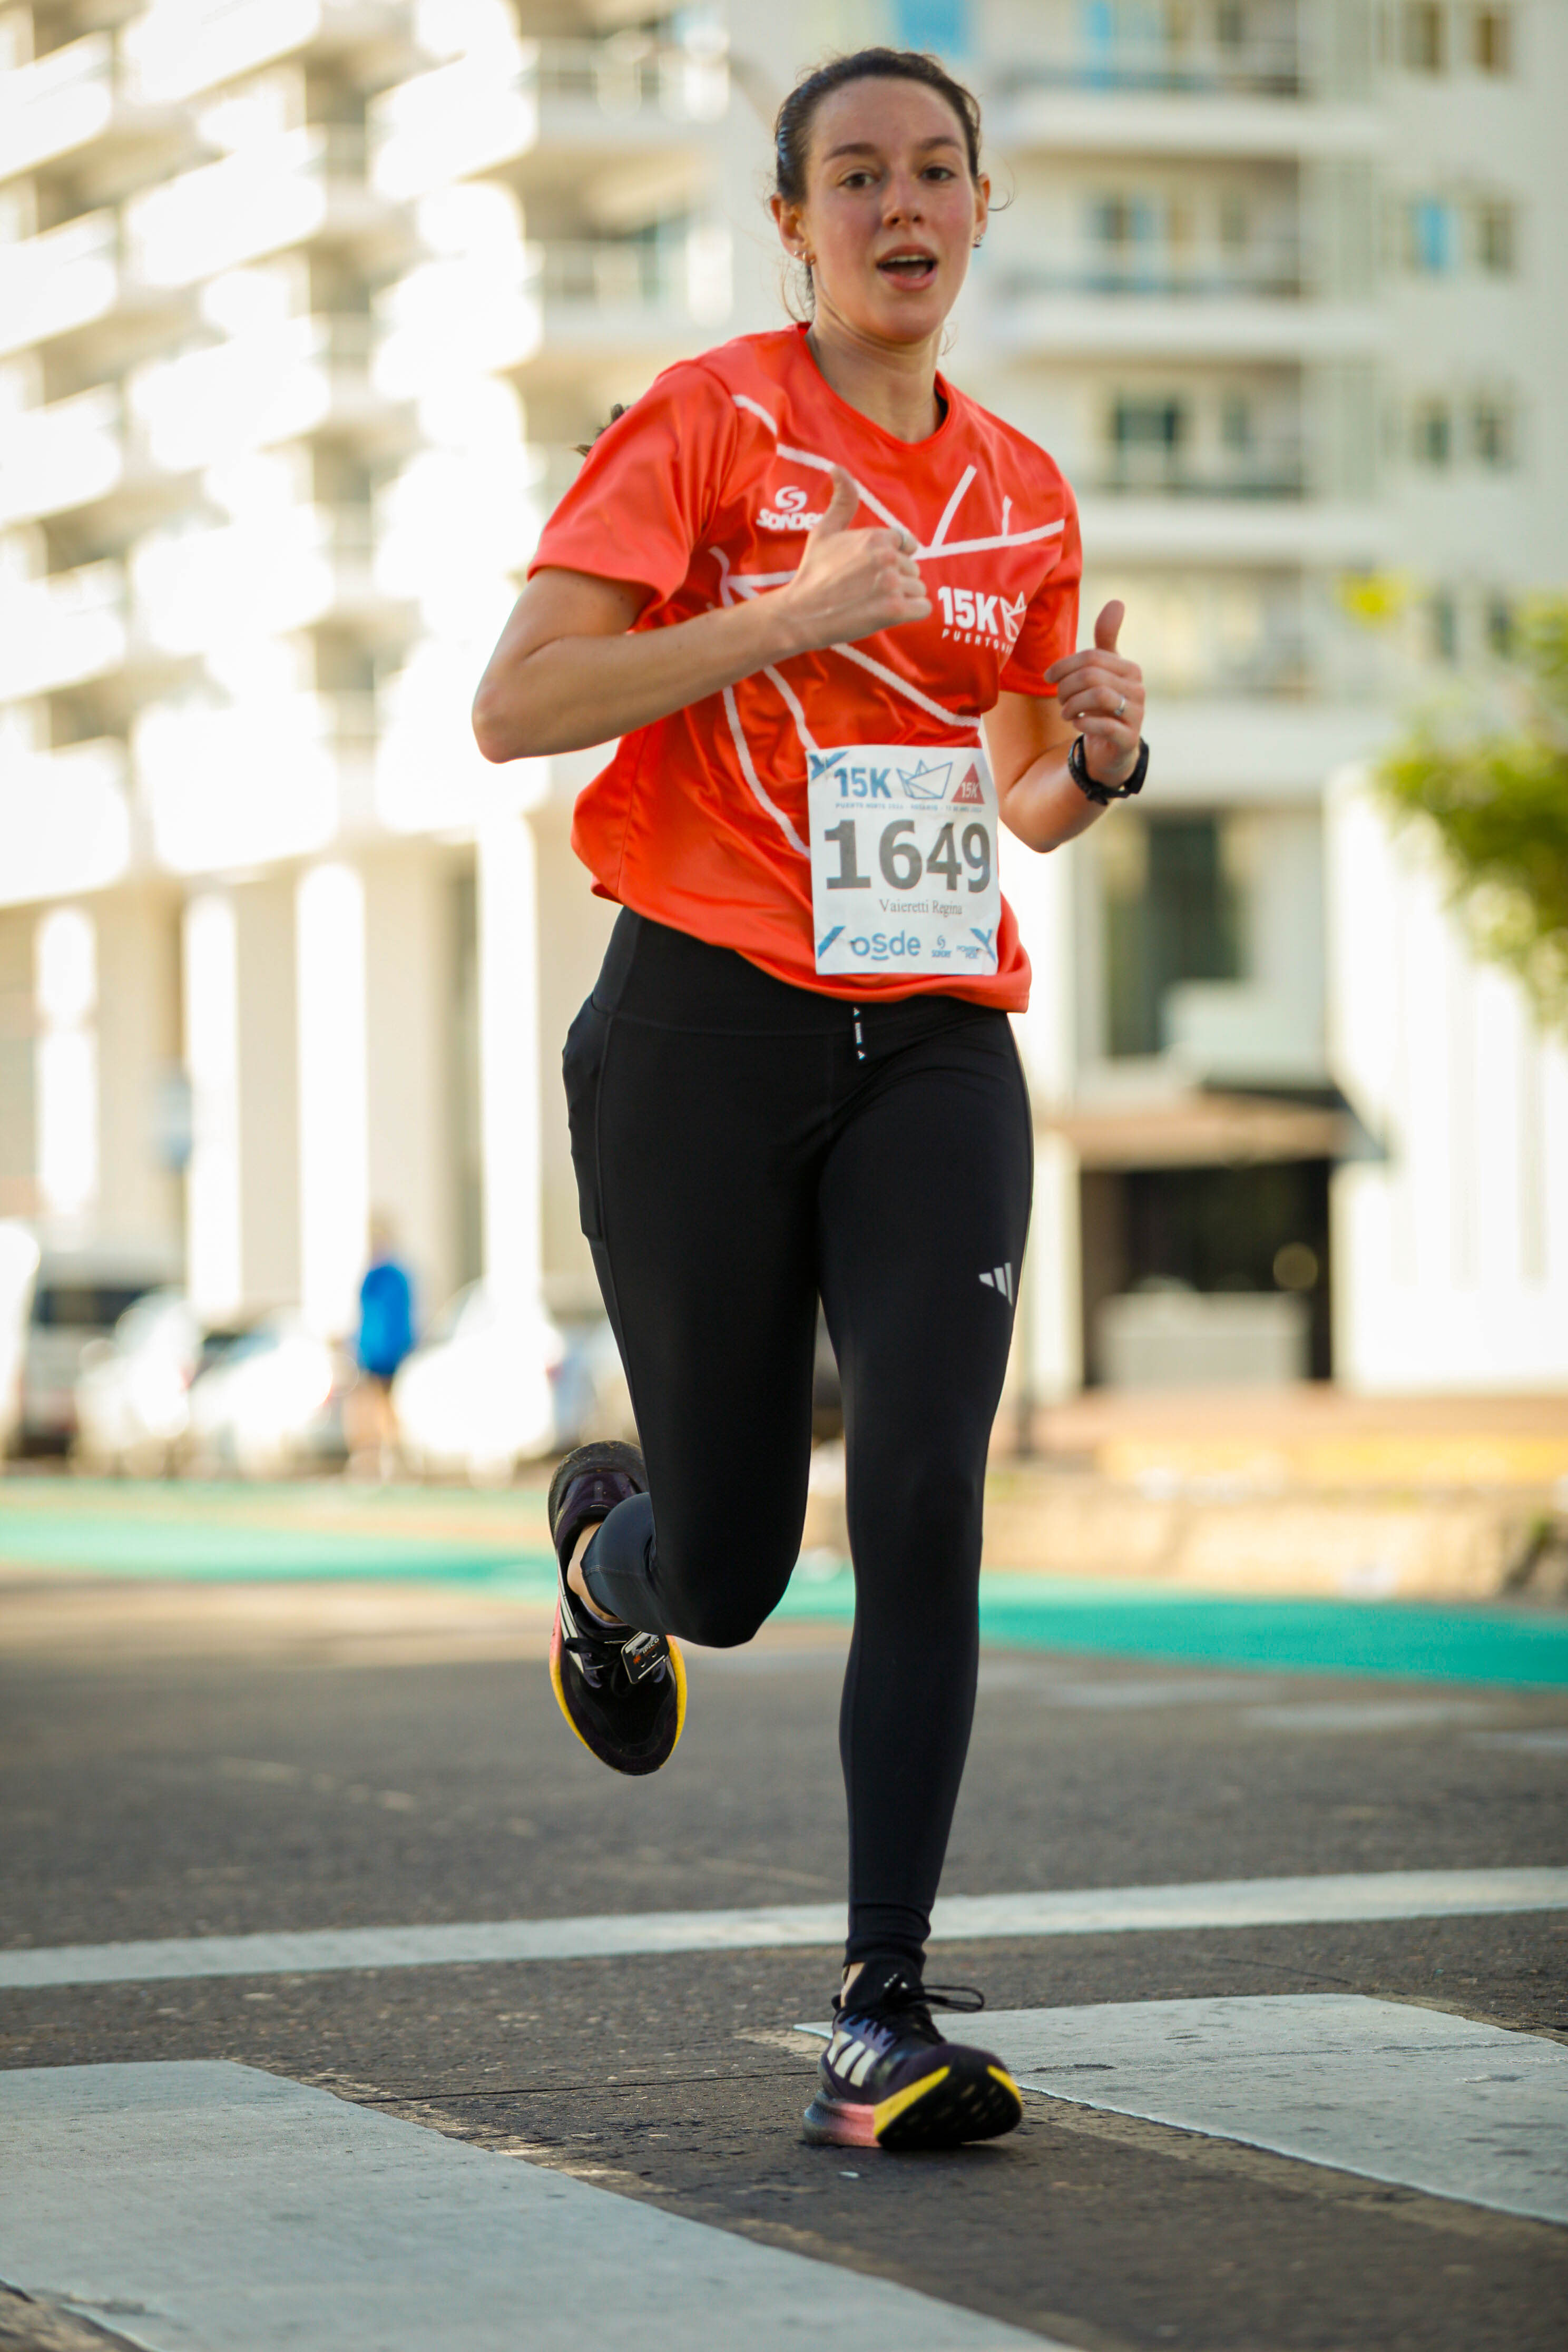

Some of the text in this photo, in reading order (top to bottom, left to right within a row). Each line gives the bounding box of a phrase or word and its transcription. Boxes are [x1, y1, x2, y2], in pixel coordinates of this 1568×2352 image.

[938, 586, 998, 635] 15K
[942, 628, 999, 649] PUERTO
[834, 767, 892, 798] 15K
[962, 782, 980, 799] 15K
[824, 819, 991, 893] 1649
[932, 899, 963, 918] Regina
[850, 930, 921, 957] osde
